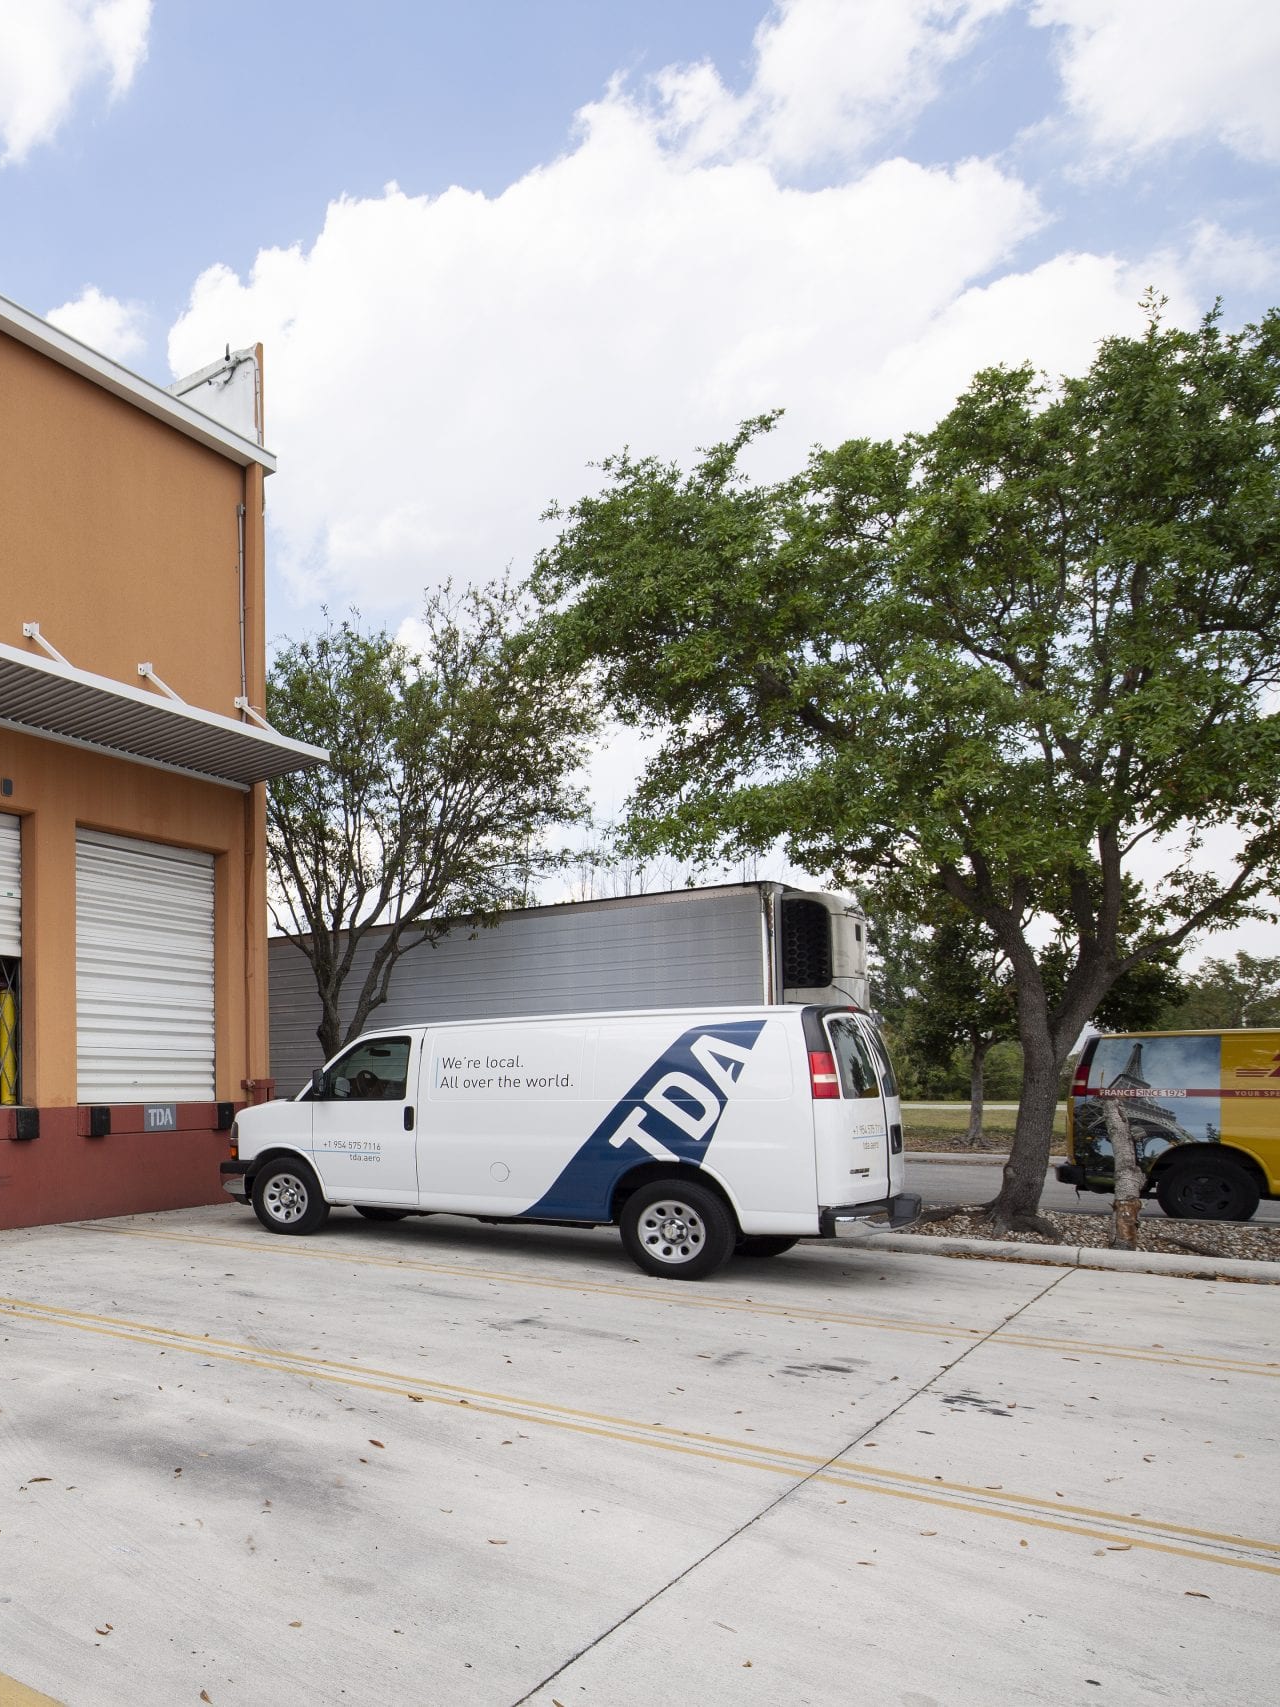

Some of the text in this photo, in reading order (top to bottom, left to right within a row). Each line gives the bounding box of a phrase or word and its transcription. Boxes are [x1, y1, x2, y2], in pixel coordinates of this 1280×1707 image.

[486, 1055, 524, 1069] local.
[440, 1073, 574, 1089] All over the world.
[608, 1034, 752, 1163] TDA
[1099, 1089, 1135, 1097] FRANCE
[148, 1108, 173, 1127] TDA
[333, 1140, 346, 1149] 954
[348, 1141, 361, 1150] 575
[349, 1153, 381, 1162] tda.aero
